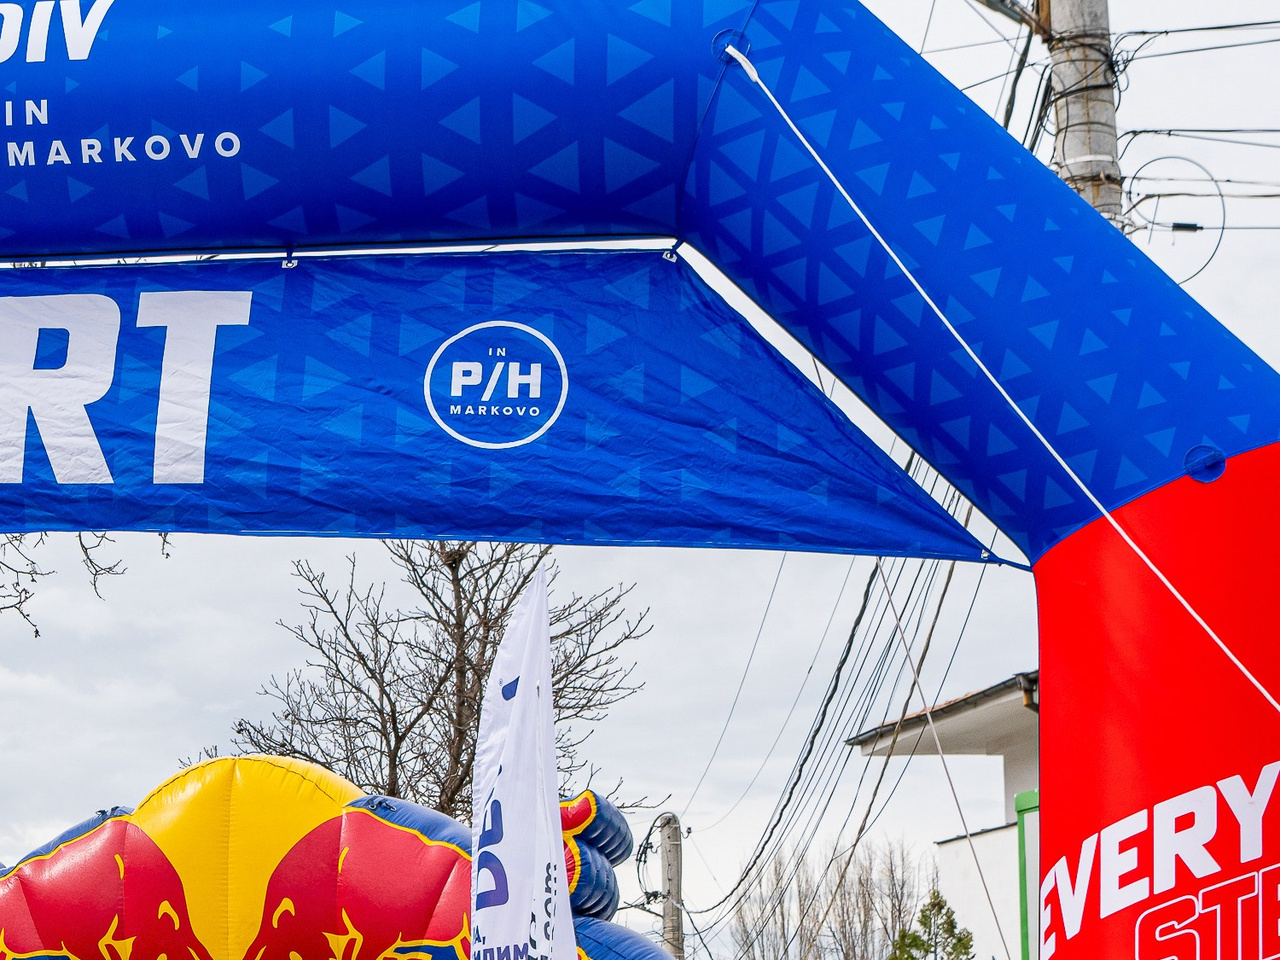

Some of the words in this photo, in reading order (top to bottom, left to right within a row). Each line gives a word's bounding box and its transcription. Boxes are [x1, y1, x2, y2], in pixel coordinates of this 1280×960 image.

[5, 99, 49, 126] IN
[6, 131, 242, 167] MARKOVO
[488, 347, 506, 357] IN
[450, 361, 542, 402] P/H
[450, 405, 540, 417] MARKOVO
